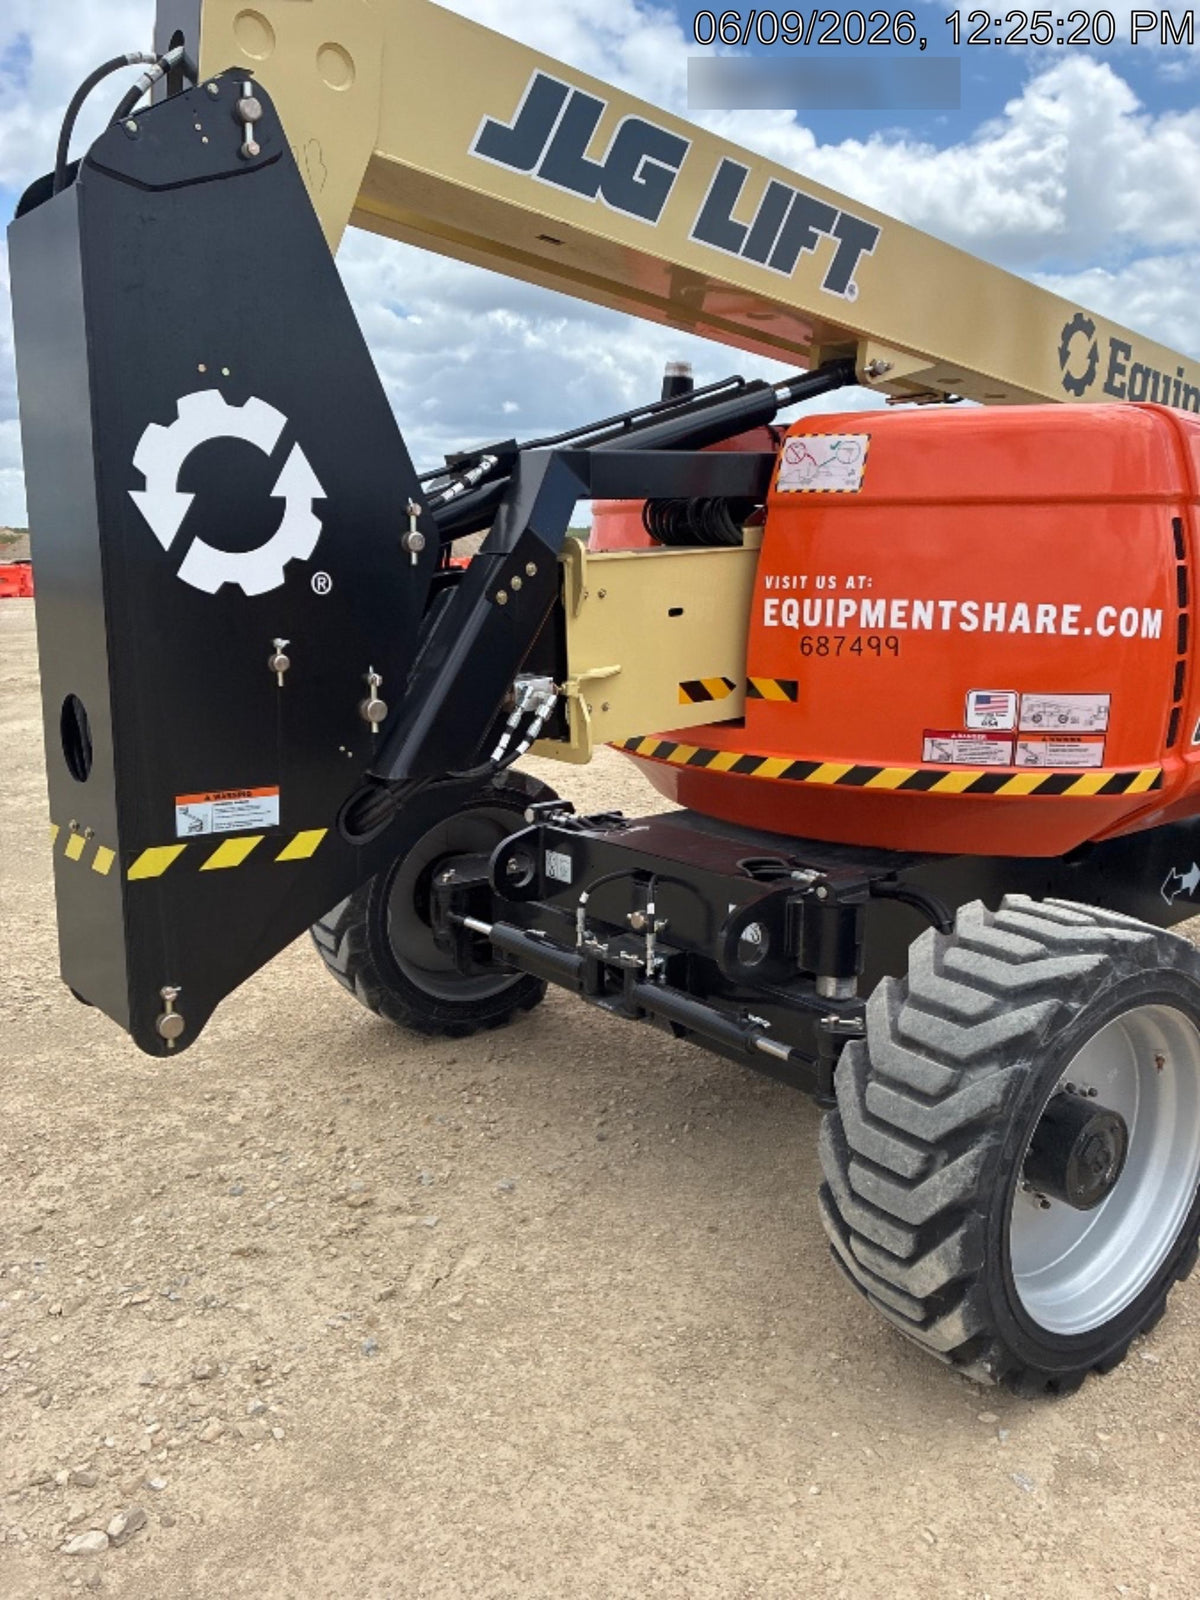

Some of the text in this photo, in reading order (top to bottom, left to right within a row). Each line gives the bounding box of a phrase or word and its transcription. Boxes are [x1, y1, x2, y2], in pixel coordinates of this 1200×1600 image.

[467, 67, 694, 228] JLG
[764, 575, 874, 590] VISIT US AT:
[763, 597, 1164, 640] EQUIPMENTSHARE.COM
[799, 635, 900, 657] 687499
